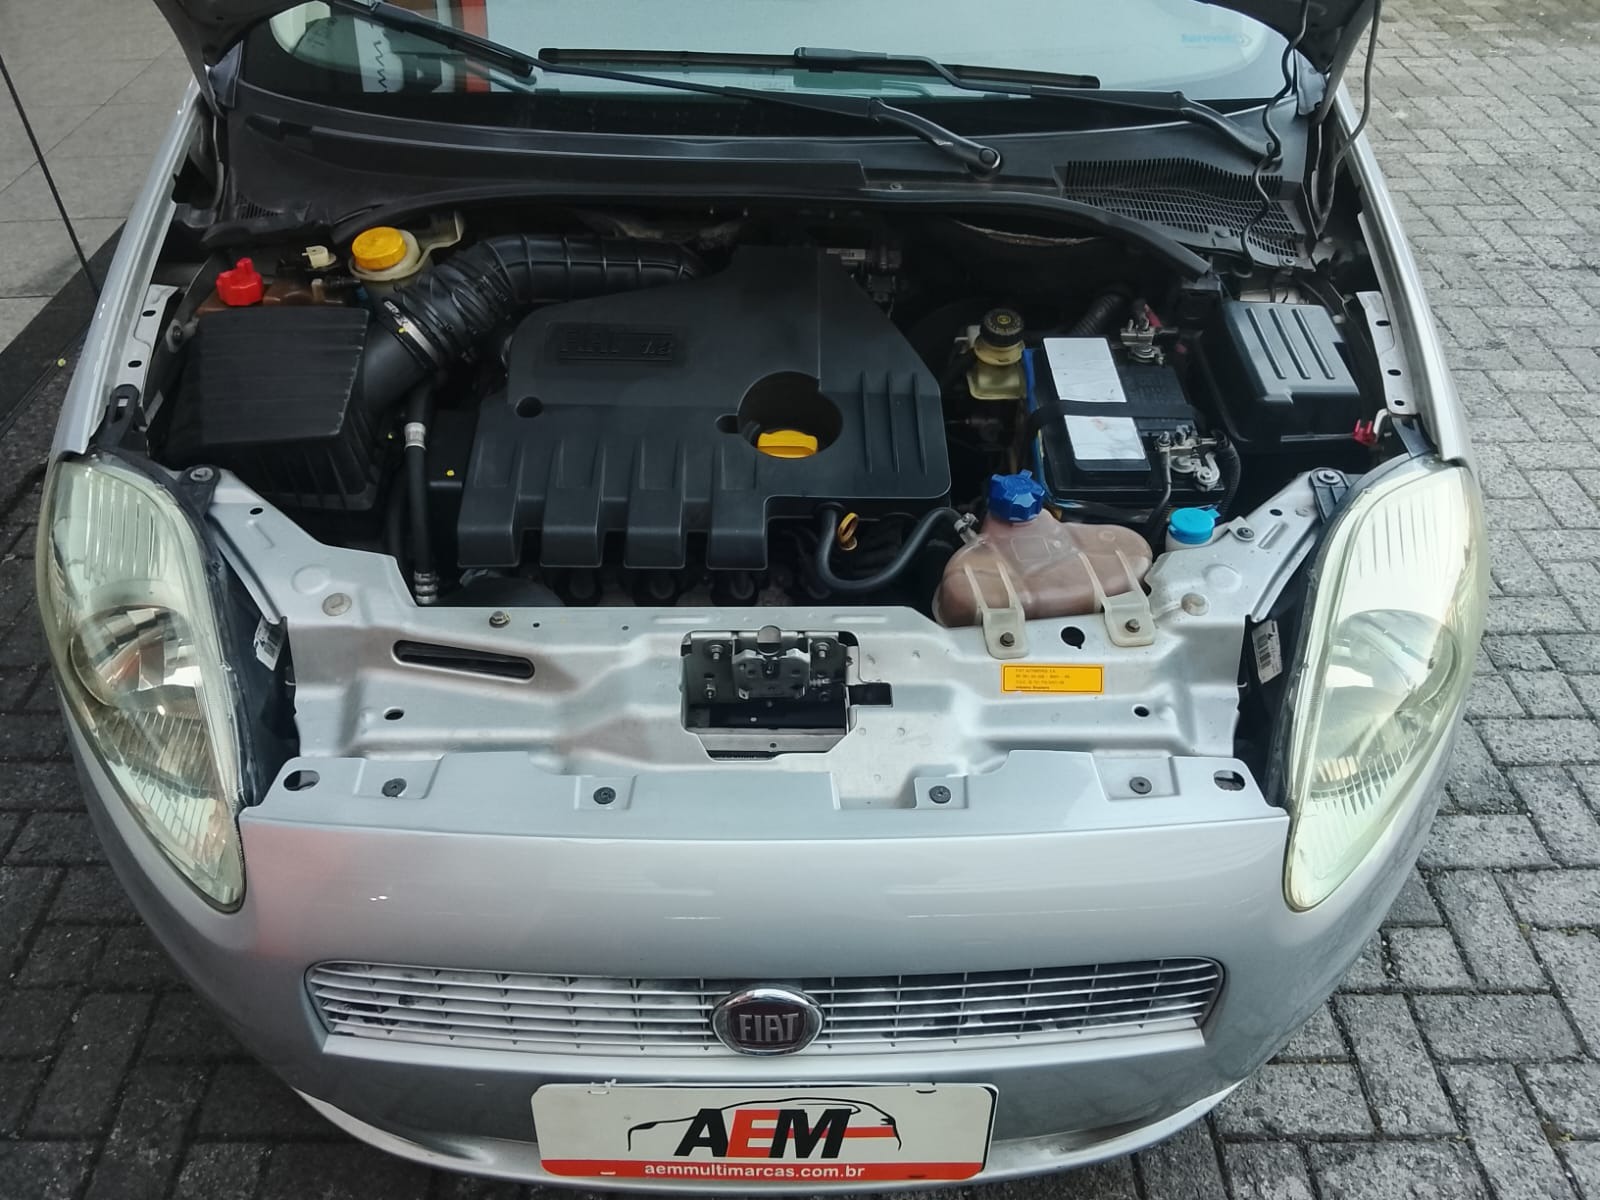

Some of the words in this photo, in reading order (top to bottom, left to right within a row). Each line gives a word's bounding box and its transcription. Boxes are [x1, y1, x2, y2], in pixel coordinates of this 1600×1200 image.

[739, 1012, 799, 1042] FIAT
[673, 1108, 852, 1159] AEM
[644, 1163, 865, 1178] aemmultimarcas.com.br
